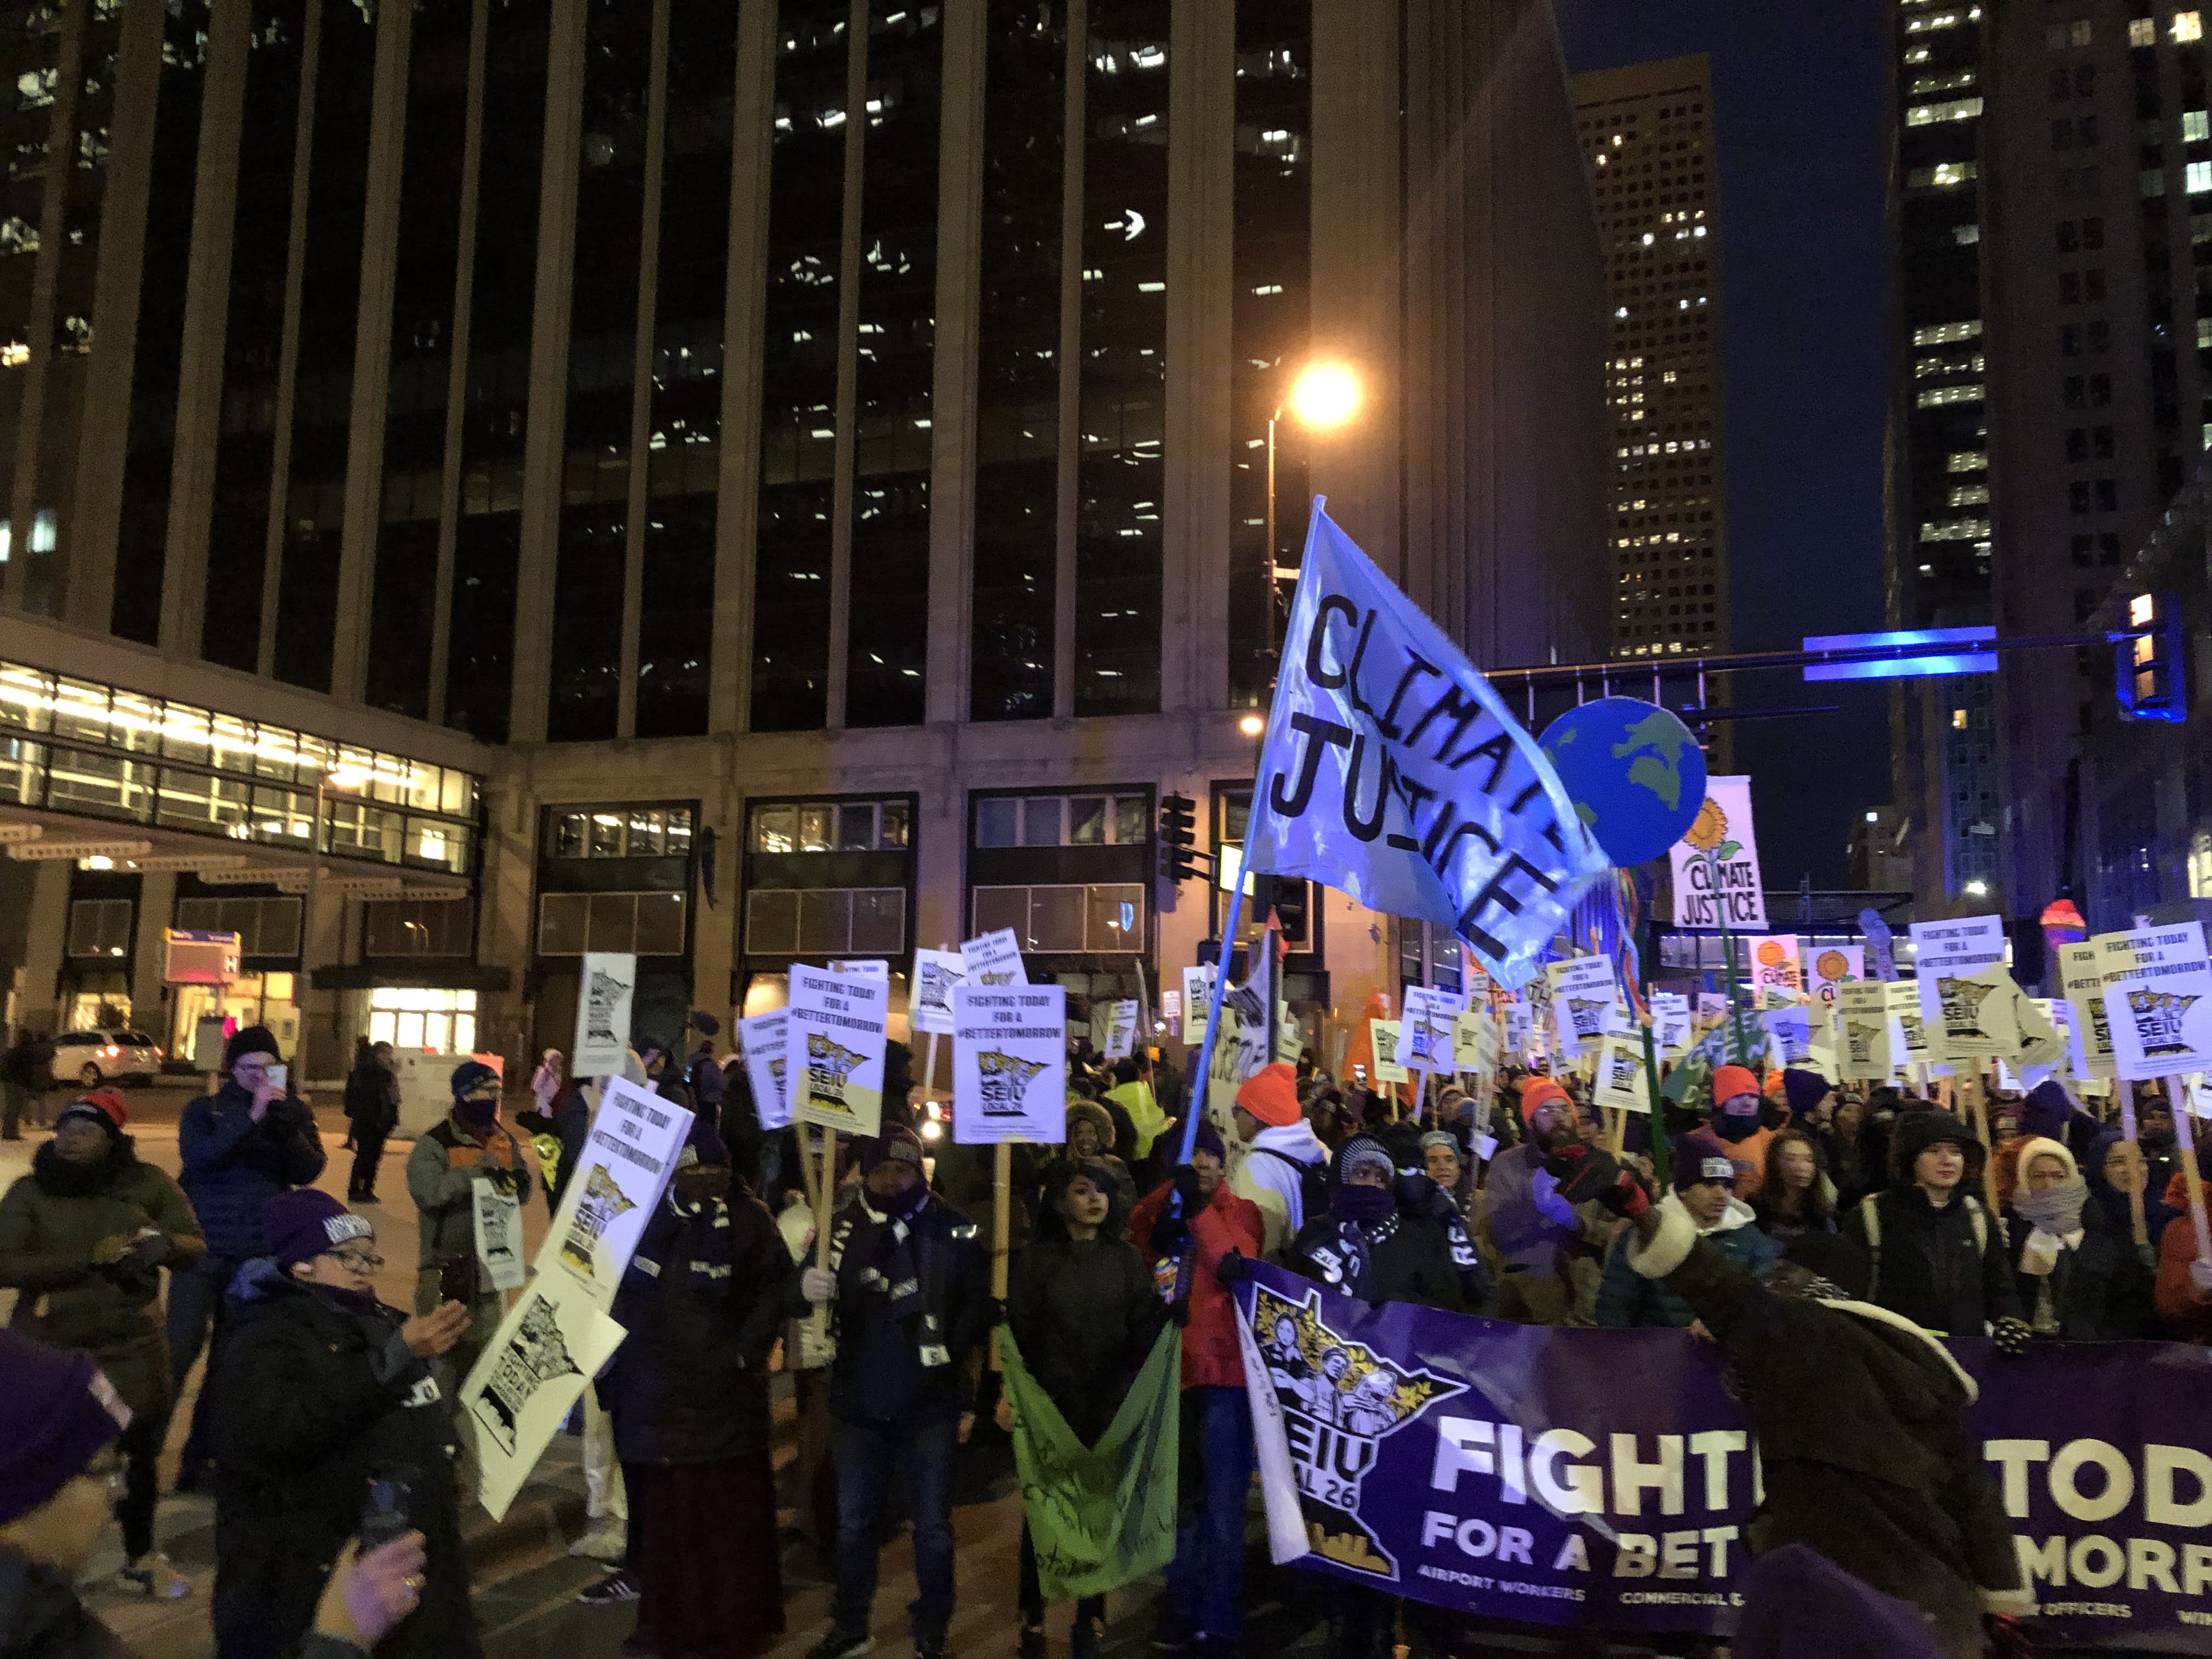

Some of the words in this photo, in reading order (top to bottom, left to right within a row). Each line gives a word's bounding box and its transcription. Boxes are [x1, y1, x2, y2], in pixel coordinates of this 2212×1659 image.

[1305, 594, 1593, 854] CLIMA
[1690, 861, 1755, 891] CLMATE
[2106, 937, 2155, 952] FIGHTING
[2156, 932, 2188, 946] TODAY
[2135, 952, 2154, 963] FOR
[2158, 951, 2165, 961] A
[2103, 960, 2207, 982] #BETTERTOMORROW
[803, 977, 844, 995] FIGHTING
[848, 985, 876, 1000] TODAY
[825, 997, 840, 1009] FOR
[843, 1001, 849, 1012] A
[966, 995, 1015, 1007] FIGHTING
[1018, 995, 1052, 1007] TODAY
[792, 1007, 884, 1034] #BETTERTOMORROW
[992, 1011, 1013, 1023] FOR
[1015, 1012, 1023, 1023] A
[1943, 1006, 1979, 1021] SEIU
[958, 1027, 1062, 1040] #BETTERTOMORROW
[2137, 1019, 2183, 1038] SEIU
[2141, 1037, 2165, 1046] LOCAL
[808, 1068, 848, 1089] SEIU
[809, 1084, 832, 1095] LOCAL
[834, 1088, 844, 1097] 26
[980, 1086, 1027, 1102] SEIU
[982, 1102, 1011, 1111] LOCAL
[1289, 1417, 1373, 1483] EIU
[1983, 1438, 2212, 1528] TOD
[1325, 1479, 1356, 1509] 26
[1422, 1510, 1533, 1566] FOR
[1554, 1531, 1592, 1572] A
[1613, 1525, 1739, 1581] BET
[1417, 1564, 1496, 1590] AIRPORT
[1497, 1579, 1586, 1601] WORKERS
[1618, 1591, 1729, 1606] COMMERCIAL
